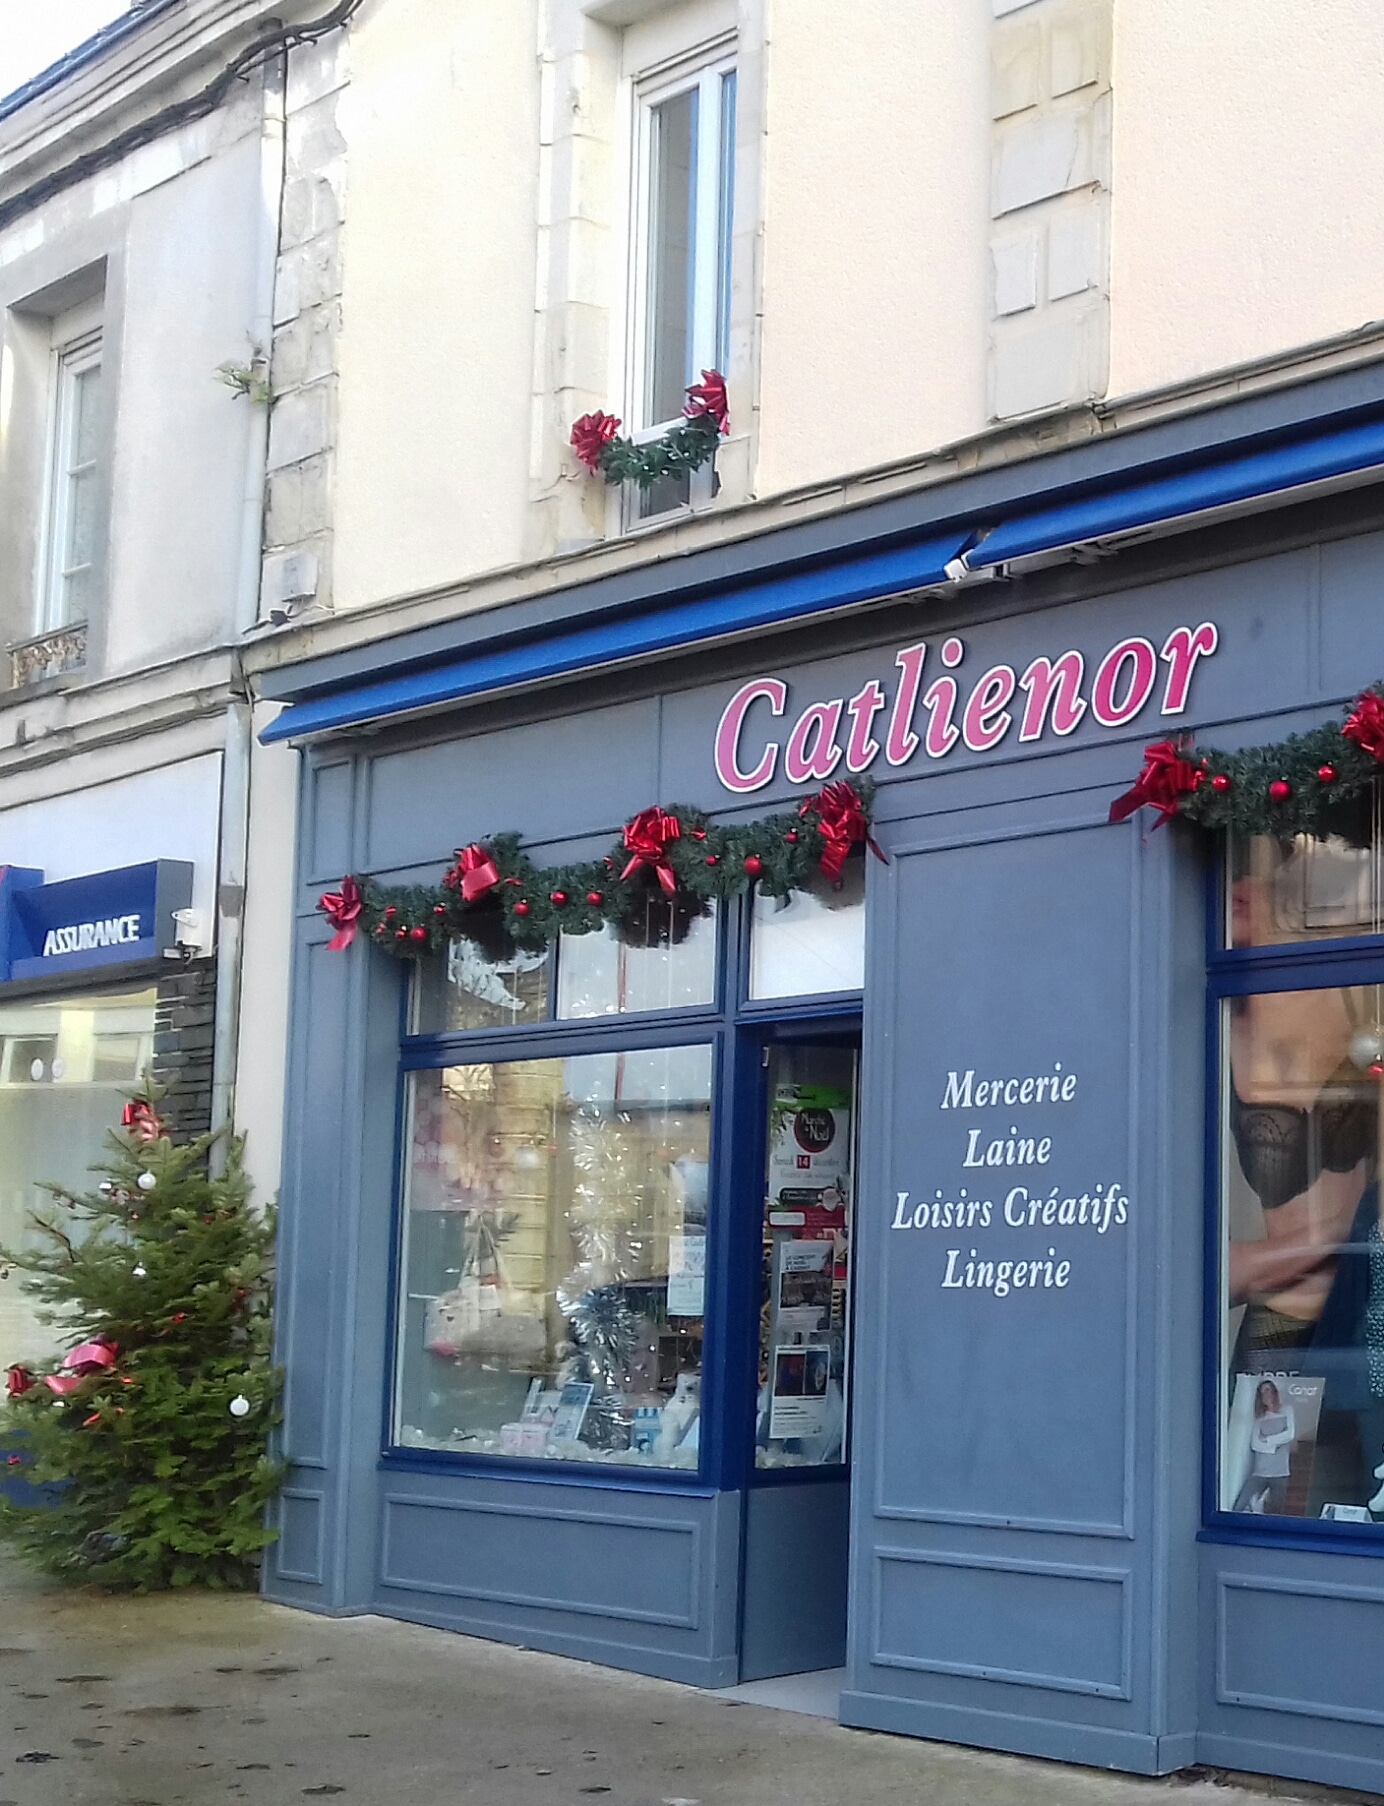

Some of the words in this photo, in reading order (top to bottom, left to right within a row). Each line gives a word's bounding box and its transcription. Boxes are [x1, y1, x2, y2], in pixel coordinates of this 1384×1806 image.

[714, 621, 1219, 793] Catlienor
[42, 914, 141, 957] ASSURANCE
[940, 1062, 1078, 1110] Mercerie
[963, 1126, 1053, 1168] Laine
[891, 1189, 994, 1230] Loisirs
[1003, 1183, 1129, 1235] Créatifs
[940, 1246, 1071, 1297] Lingerie
